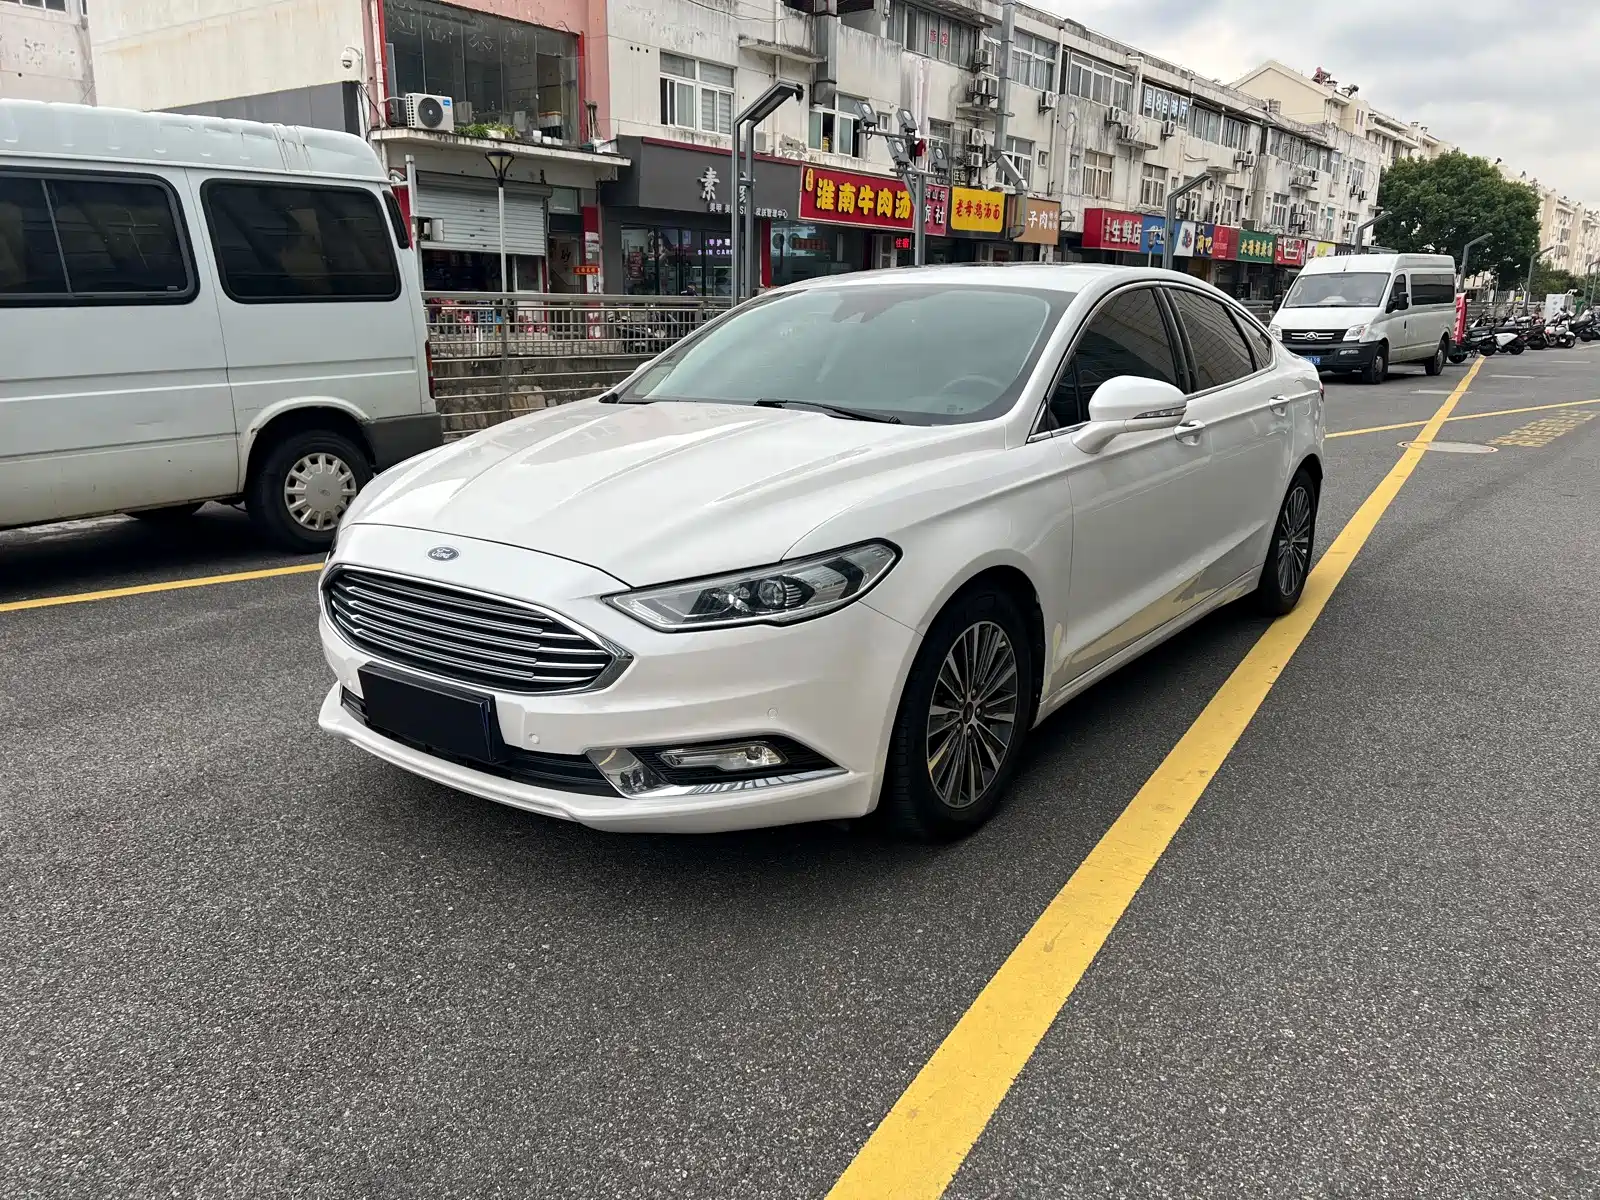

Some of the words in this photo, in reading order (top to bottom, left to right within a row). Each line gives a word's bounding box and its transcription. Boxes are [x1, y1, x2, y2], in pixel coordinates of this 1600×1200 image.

[816, 177, 911, 219] 淮南牛肉汤
[1111, 219, 1142, 244] 生鲜店
[895, 238, 910, 248] 住宿
[430, 547, 456, 560] Ford
